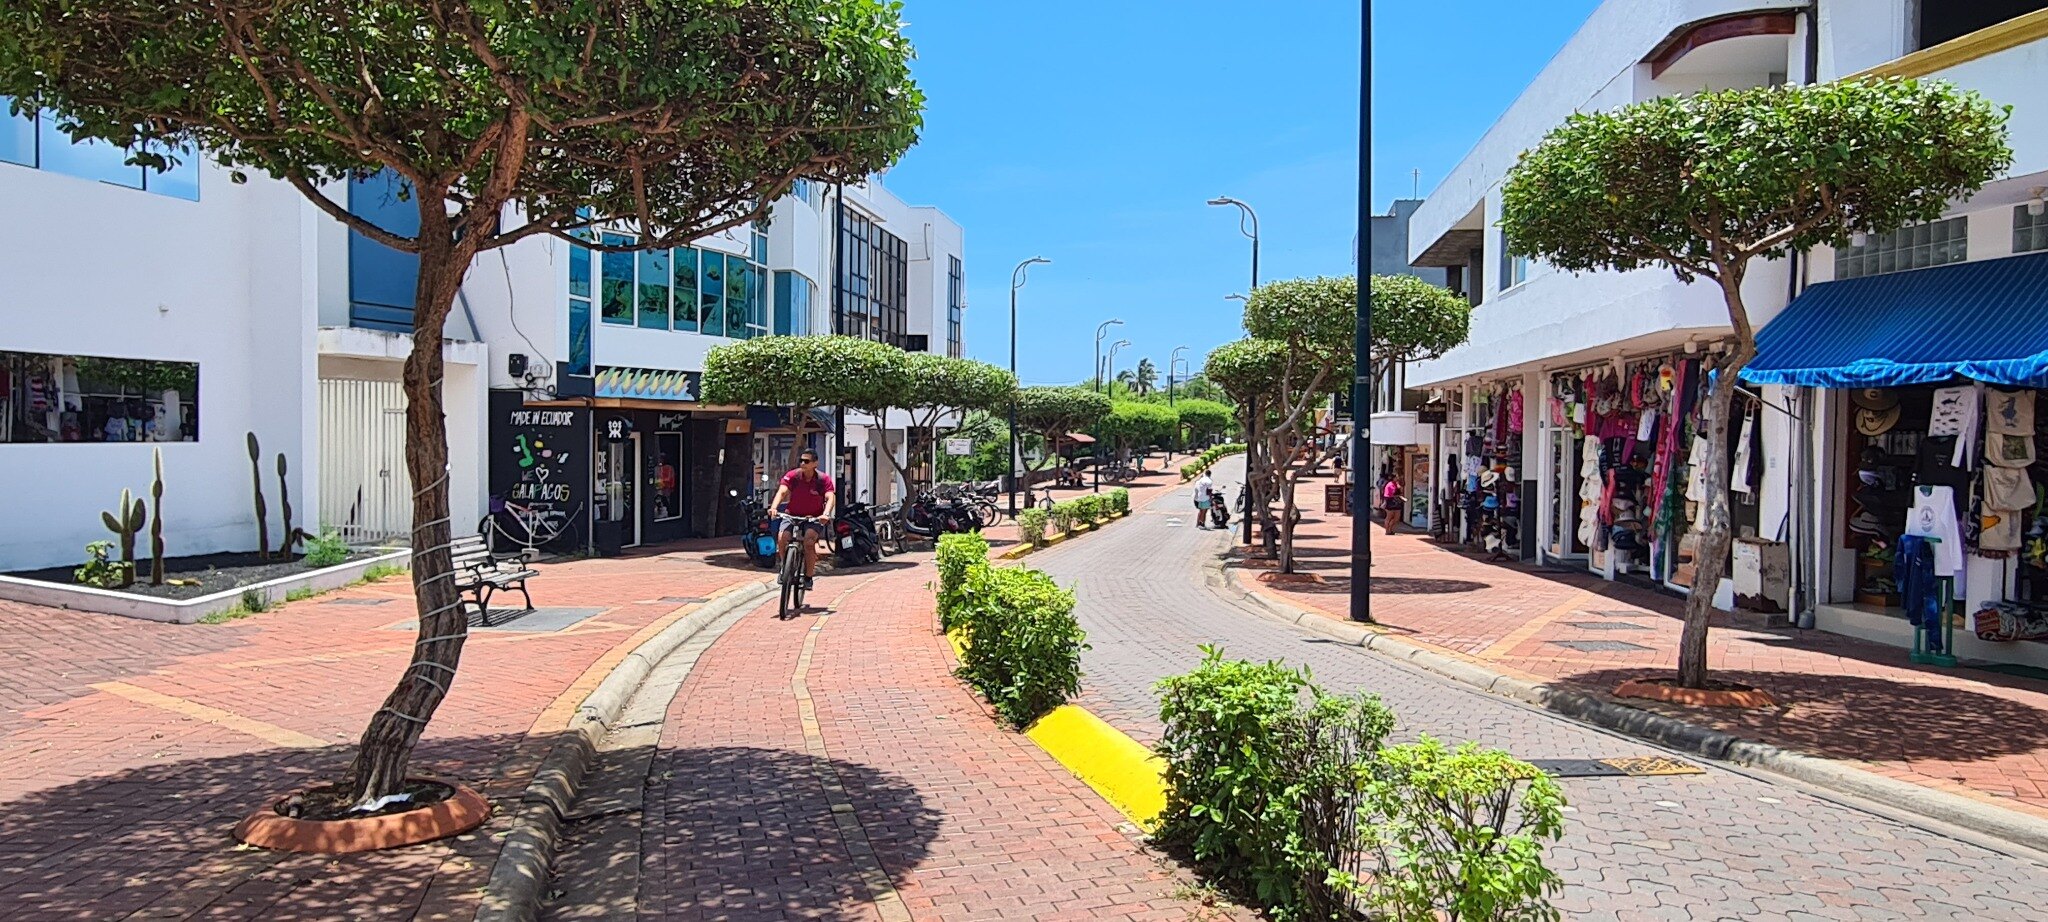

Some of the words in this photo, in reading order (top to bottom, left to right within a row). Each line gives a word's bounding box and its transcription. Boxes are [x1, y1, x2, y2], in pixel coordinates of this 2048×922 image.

[510, 411, 531, 426] MADE
[532, 411, 540, 425] IN
[541, 411, 574, 426] ECUADOR
[521, 470, 534, 482] WE
[512, 484, 570, 502] GALAPAGOS
